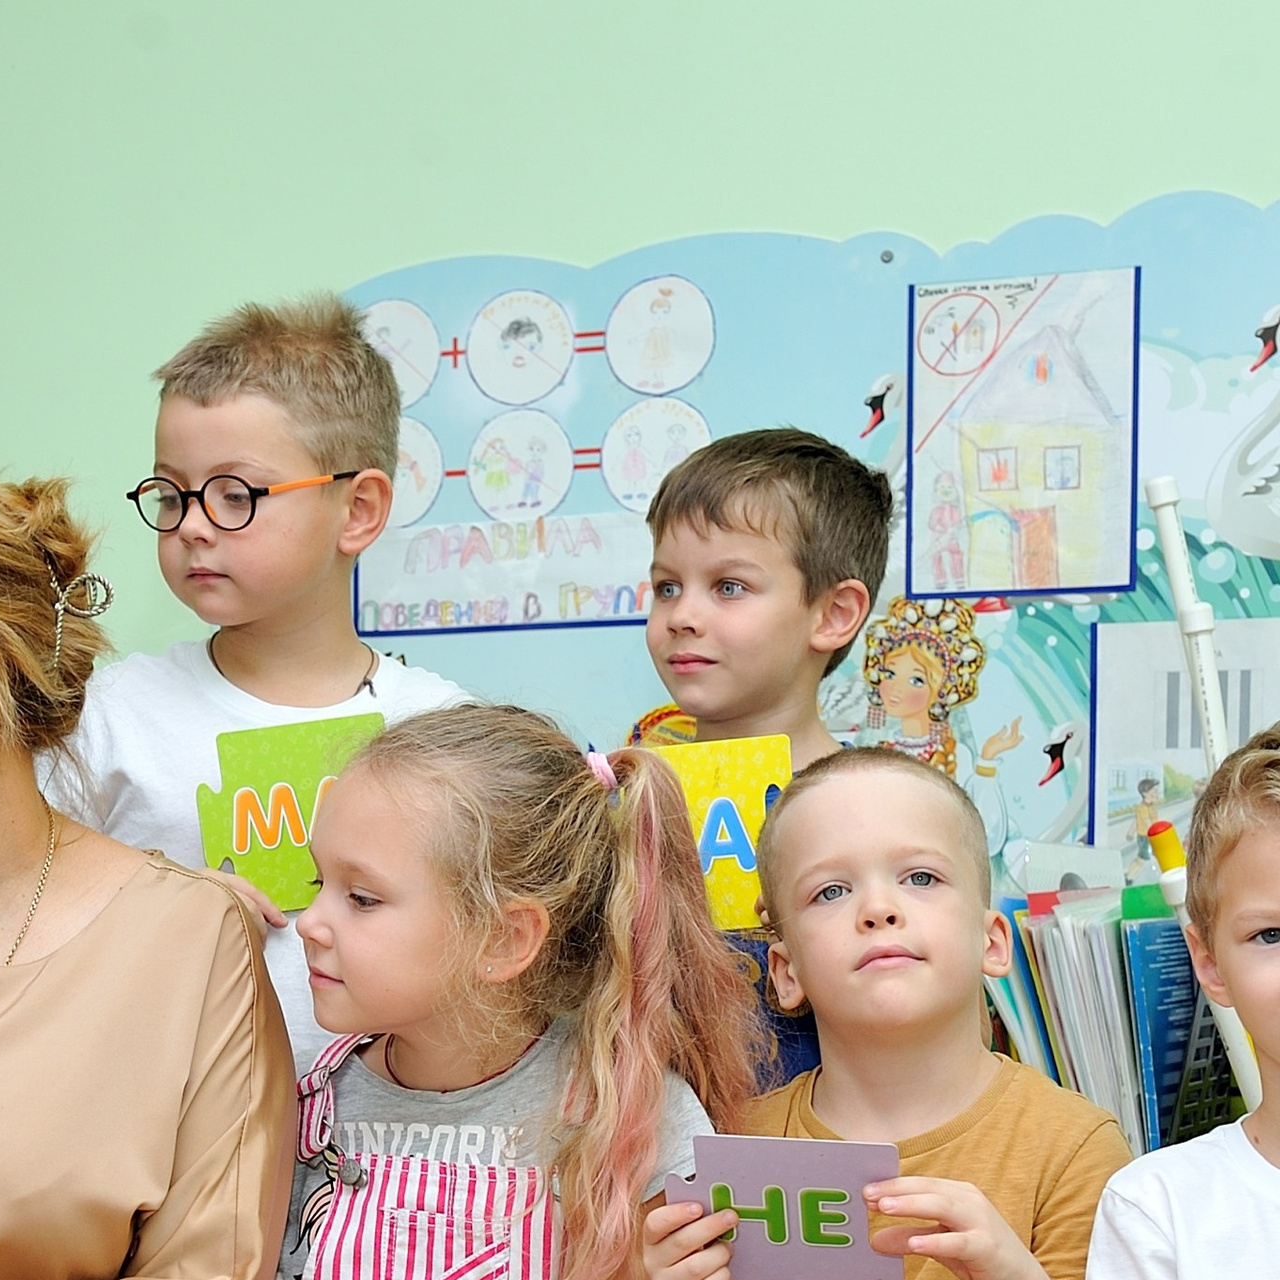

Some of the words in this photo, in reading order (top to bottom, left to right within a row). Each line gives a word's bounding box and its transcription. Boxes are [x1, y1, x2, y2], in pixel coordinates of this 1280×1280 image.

[404, 516, 601, 574] ПРАВИЛА
[523, 592, 541, 622] В
[233, 775, 338, 855] М
[335, 1121, 524, 1166] UNICORN
[709, 1182, 853, 1247] НЕ
